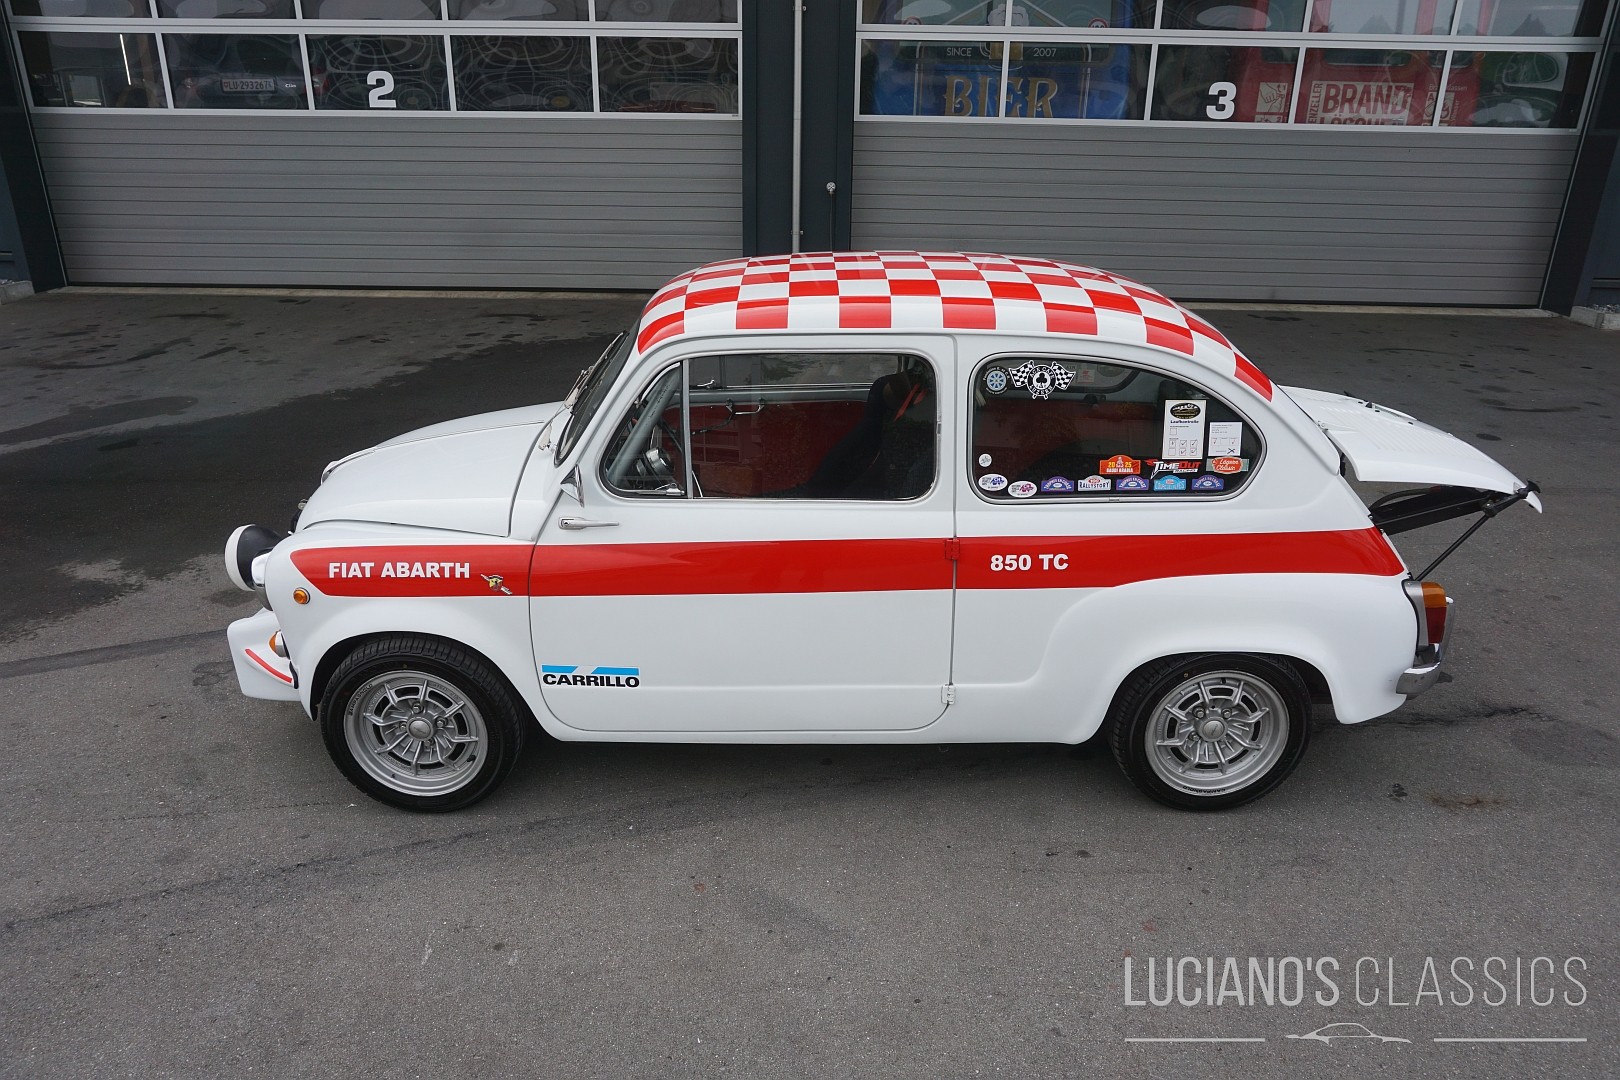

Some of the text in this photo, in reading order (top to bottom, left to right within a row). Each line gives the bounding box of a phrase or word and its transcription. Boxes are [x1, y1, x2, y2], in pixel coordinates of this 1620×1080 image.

[946, 48, 1056, 56] SINCE 2007
[368, 70, 396, 109] 2
[1206, 81, 1236, 120] 3
[1322, 84, 1411, 115] BRAND
[328, 562, 471, 579] FIAT ABARTH
[990, 553, 1069, 571] 850 TC
[542, 673, 640, 688] CARRILLO
